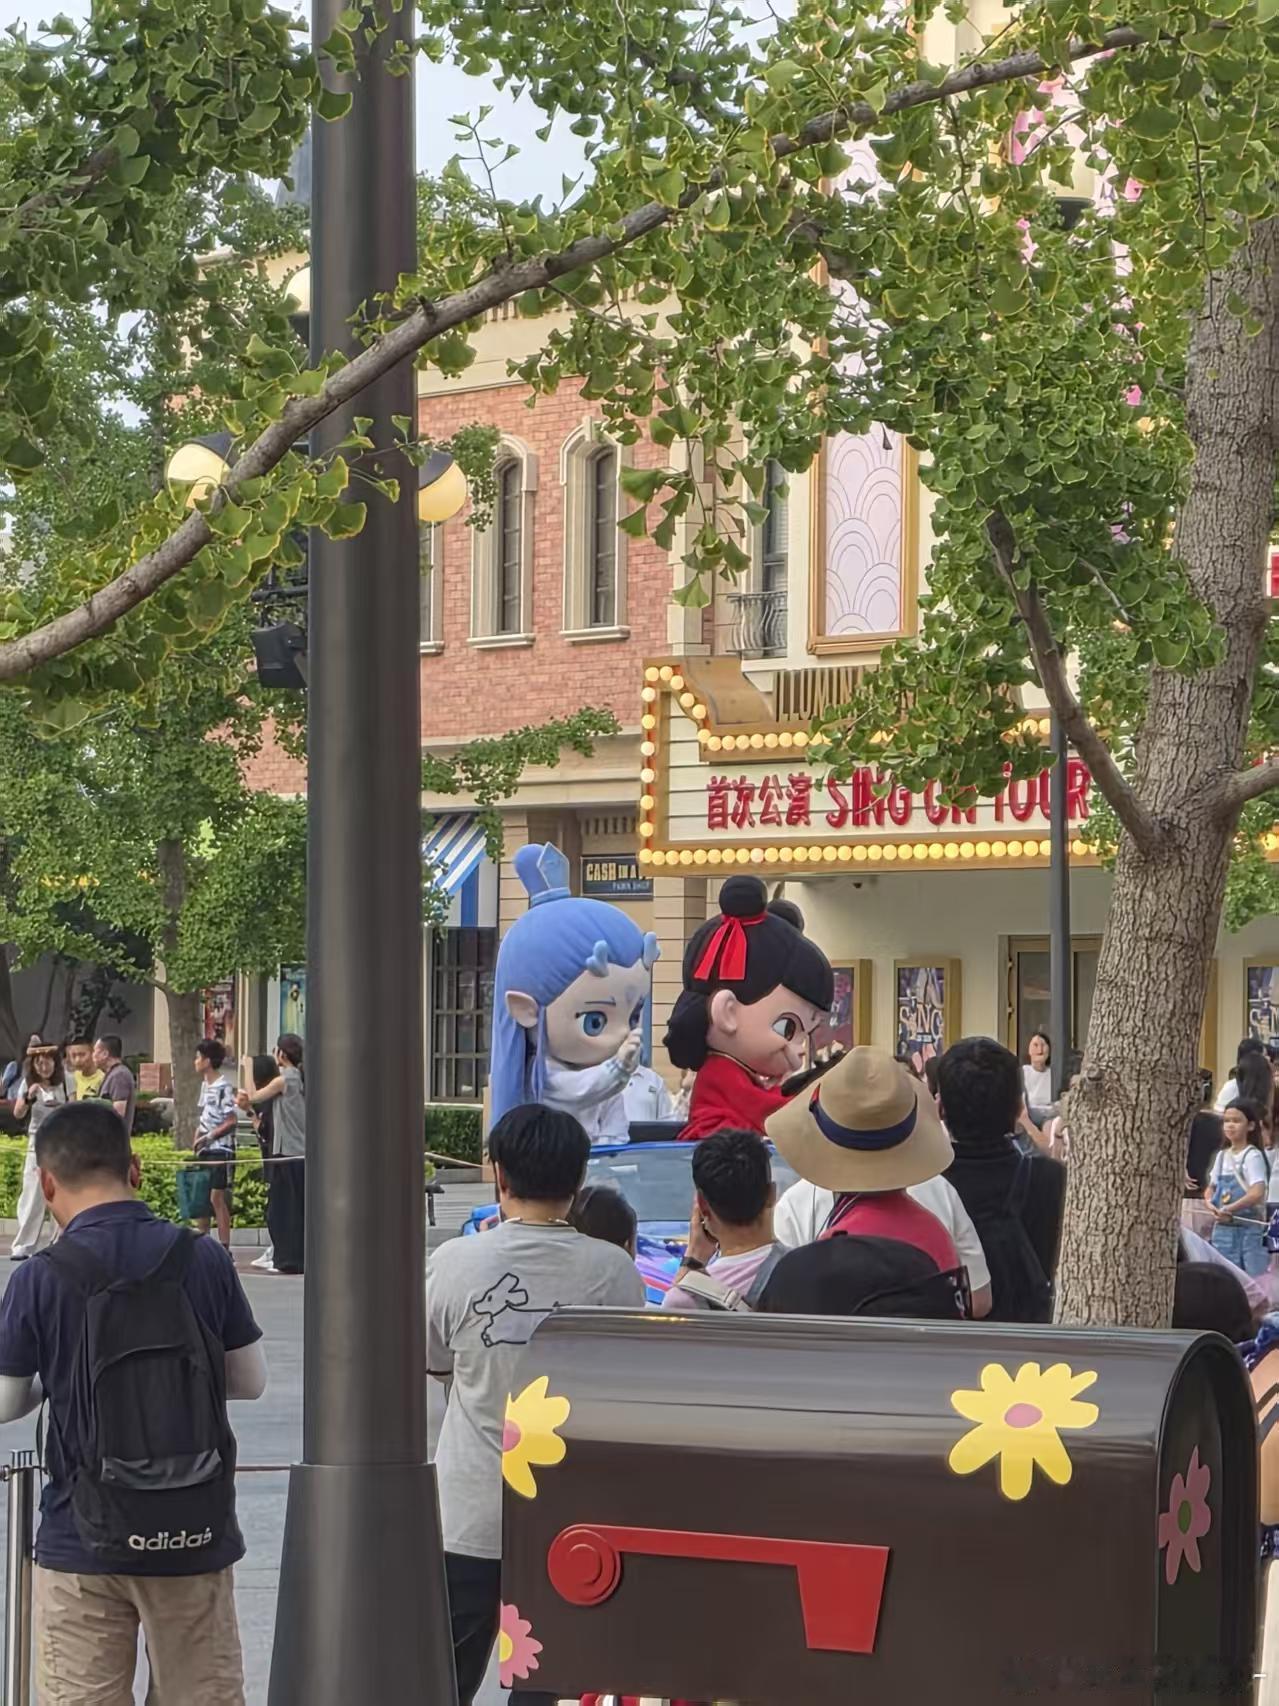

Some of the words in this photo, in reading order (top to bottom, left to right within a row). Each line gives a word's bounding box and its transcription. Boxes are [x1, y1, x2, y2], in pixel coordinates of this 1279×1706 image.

[706, 772, 812, 830] 首次公演
[826, 766, 912, 828] SING
[586, 862, 617, 881] CASH
[128, 1527, 213, 1550] adidas
